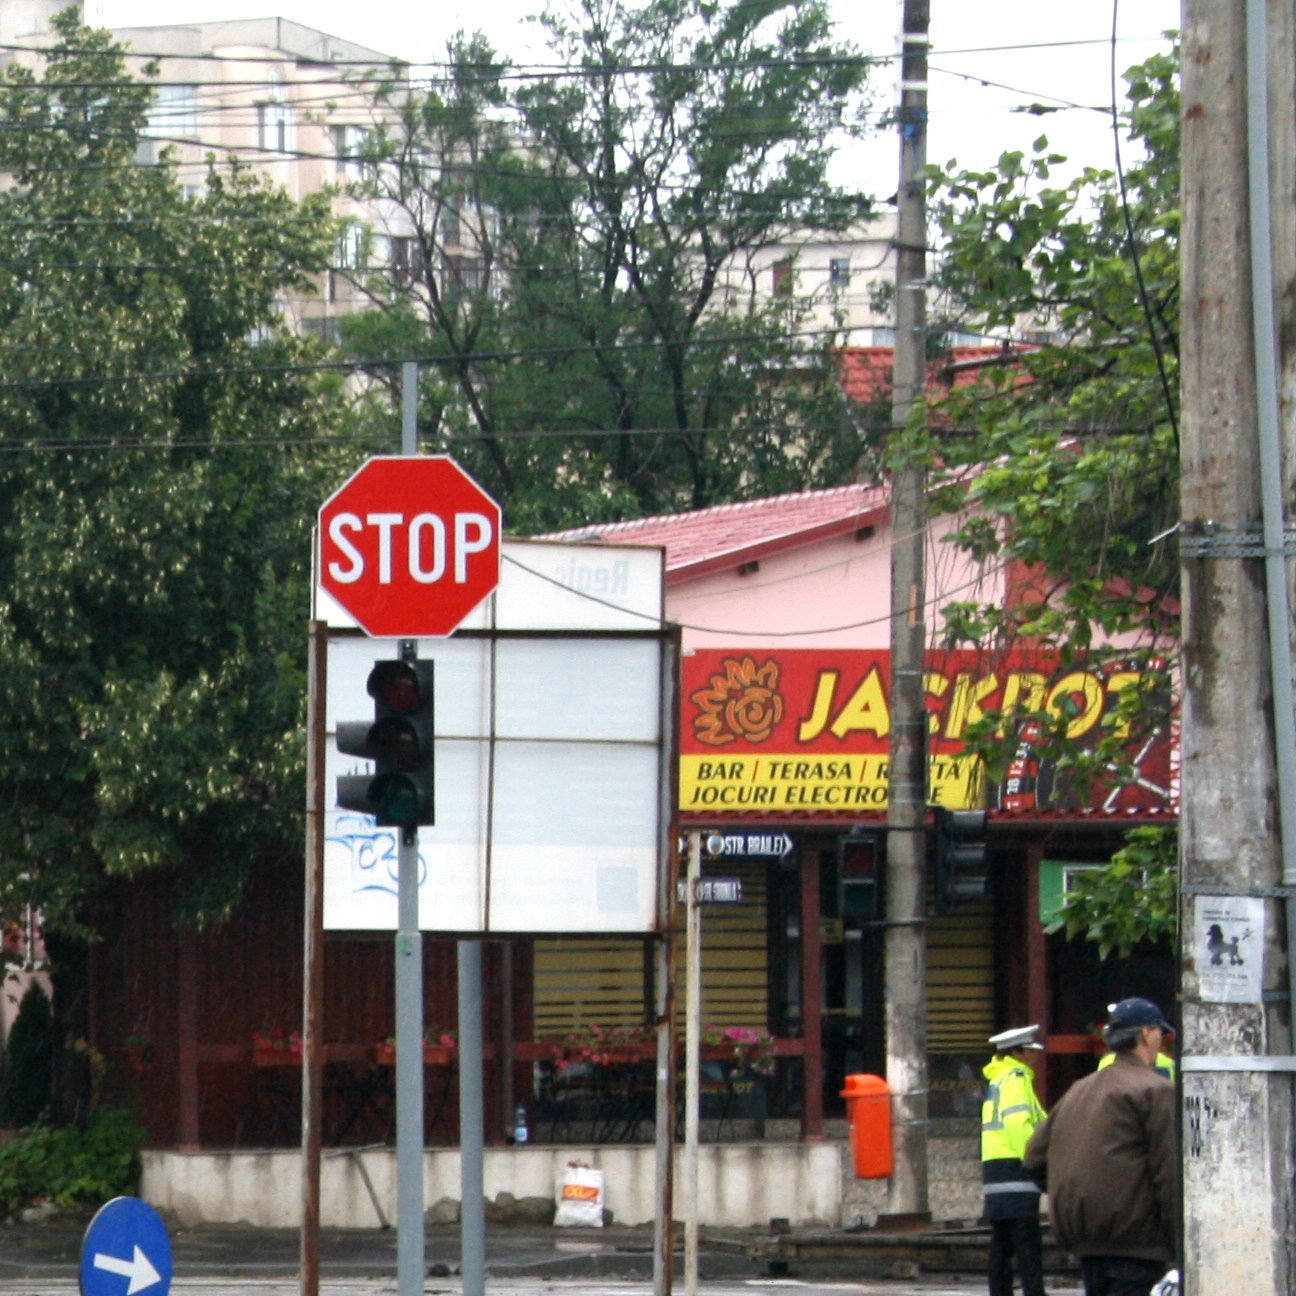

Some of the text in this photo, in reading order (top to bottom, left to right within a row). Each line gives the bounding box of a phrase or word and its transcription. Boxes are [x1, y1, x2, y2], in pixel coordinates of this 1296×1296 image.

[328, 512, 492, 584] STOP
[697, 762, 960, 780] BAR TERASA RTA
[690, 786, 943, 805] JOCURI ELECTROE
